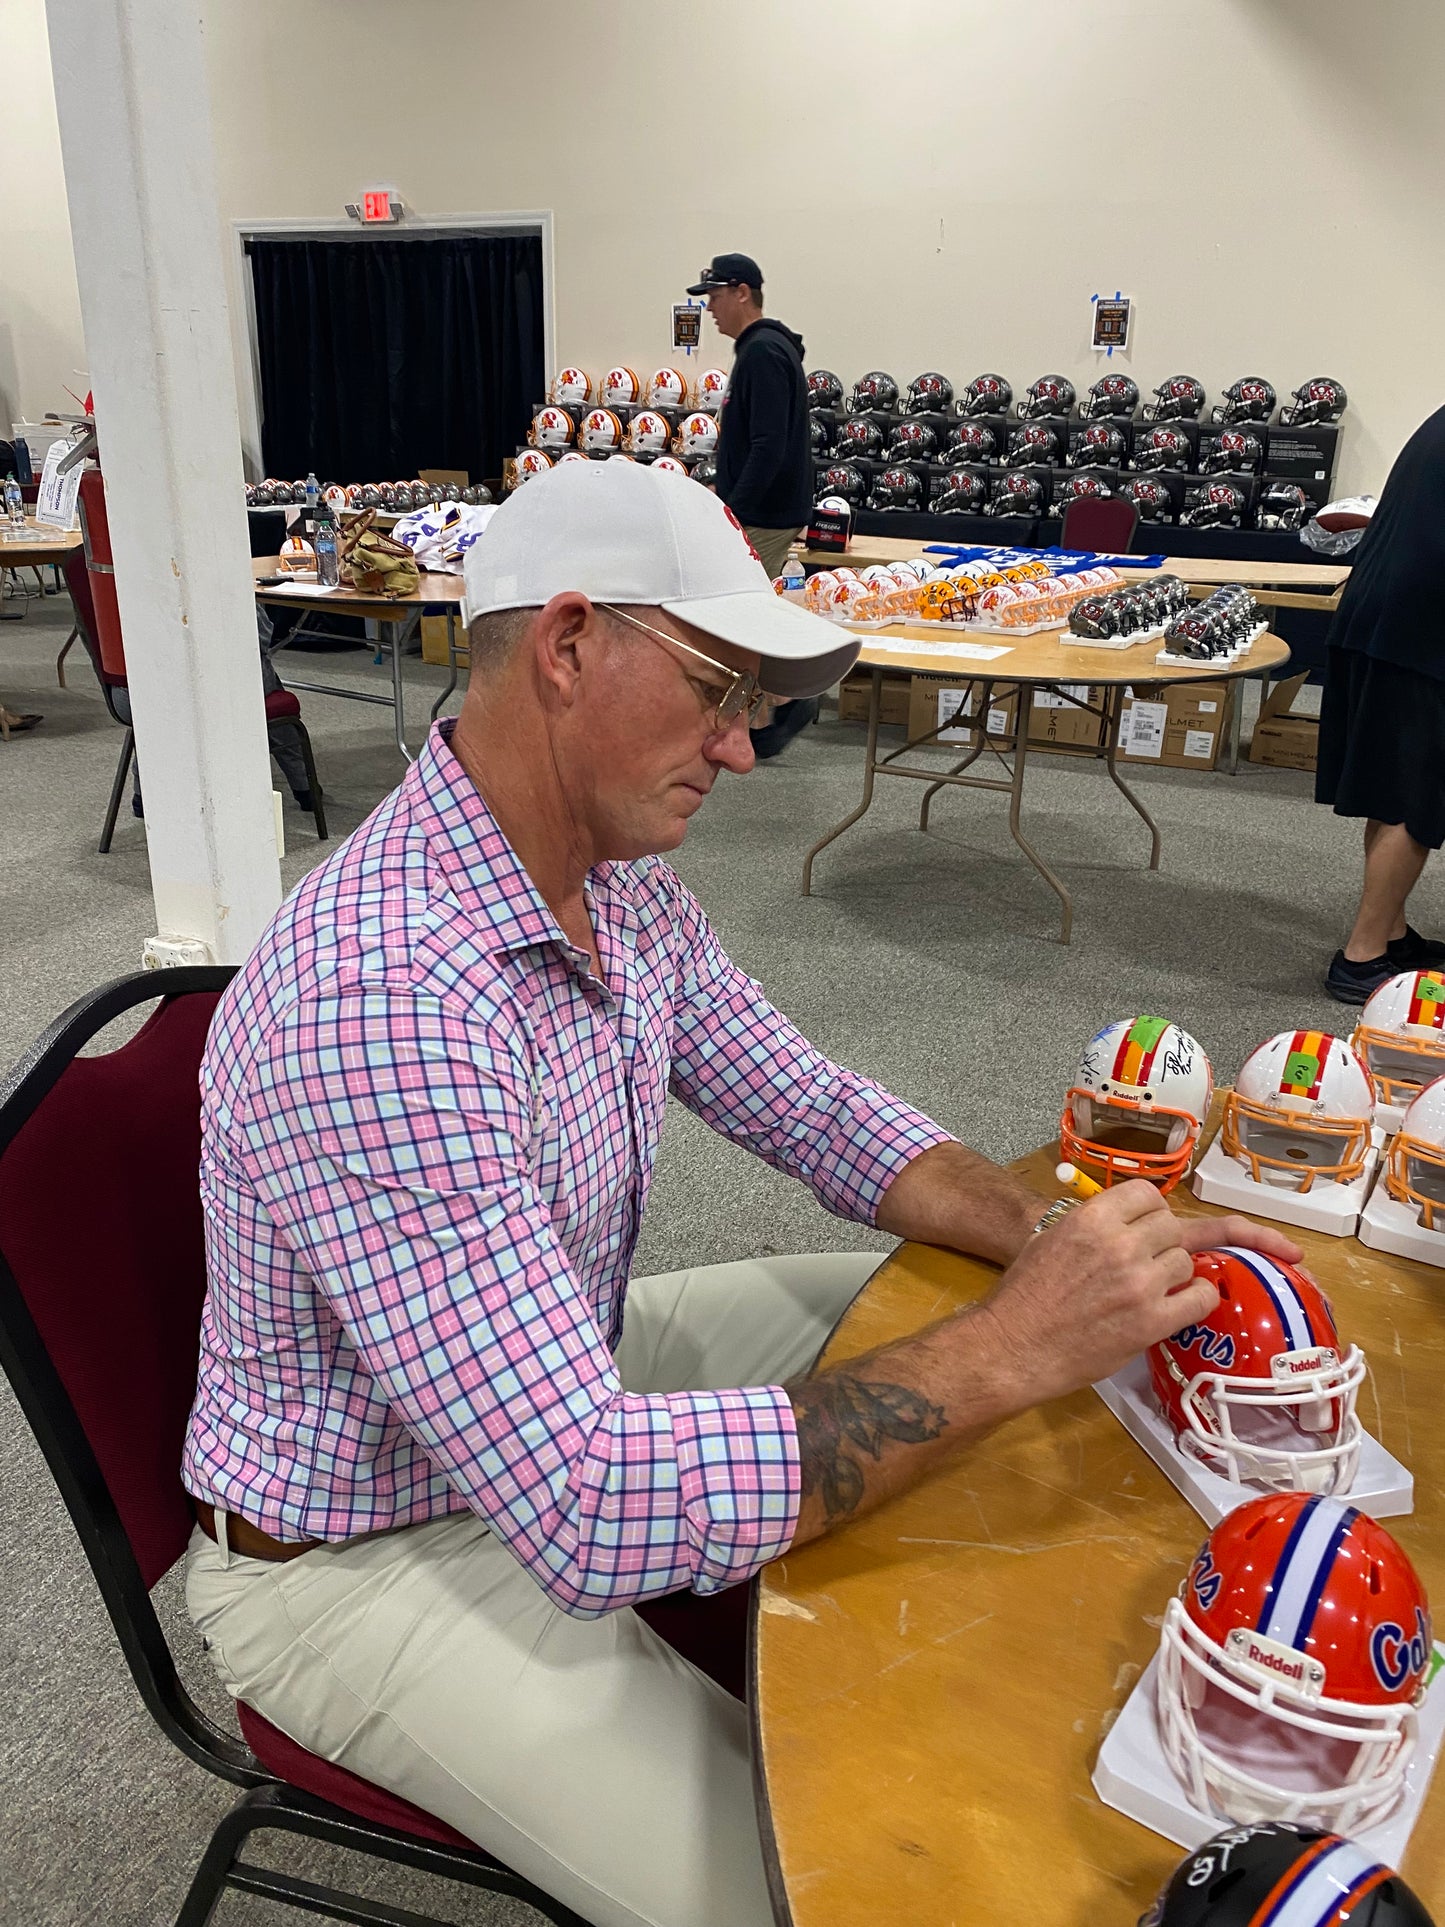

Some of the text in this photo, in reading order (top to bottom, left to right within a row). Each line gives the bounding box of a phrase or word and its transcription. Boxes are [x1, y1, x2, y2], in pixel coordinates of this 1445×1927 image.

[365, 192, 388, 219] EXIT
[55, 478, 65, 511] THOMPSON
[1166, 717, 1205, 728] LMET
[1112, 1089, 1139, 1101] Riddell
[1169, 1323, 1235, 1369] ors
[1289, 1355, 1322, 1374] Riddell
[1249, 1643, 1304, 1681] Riddell
